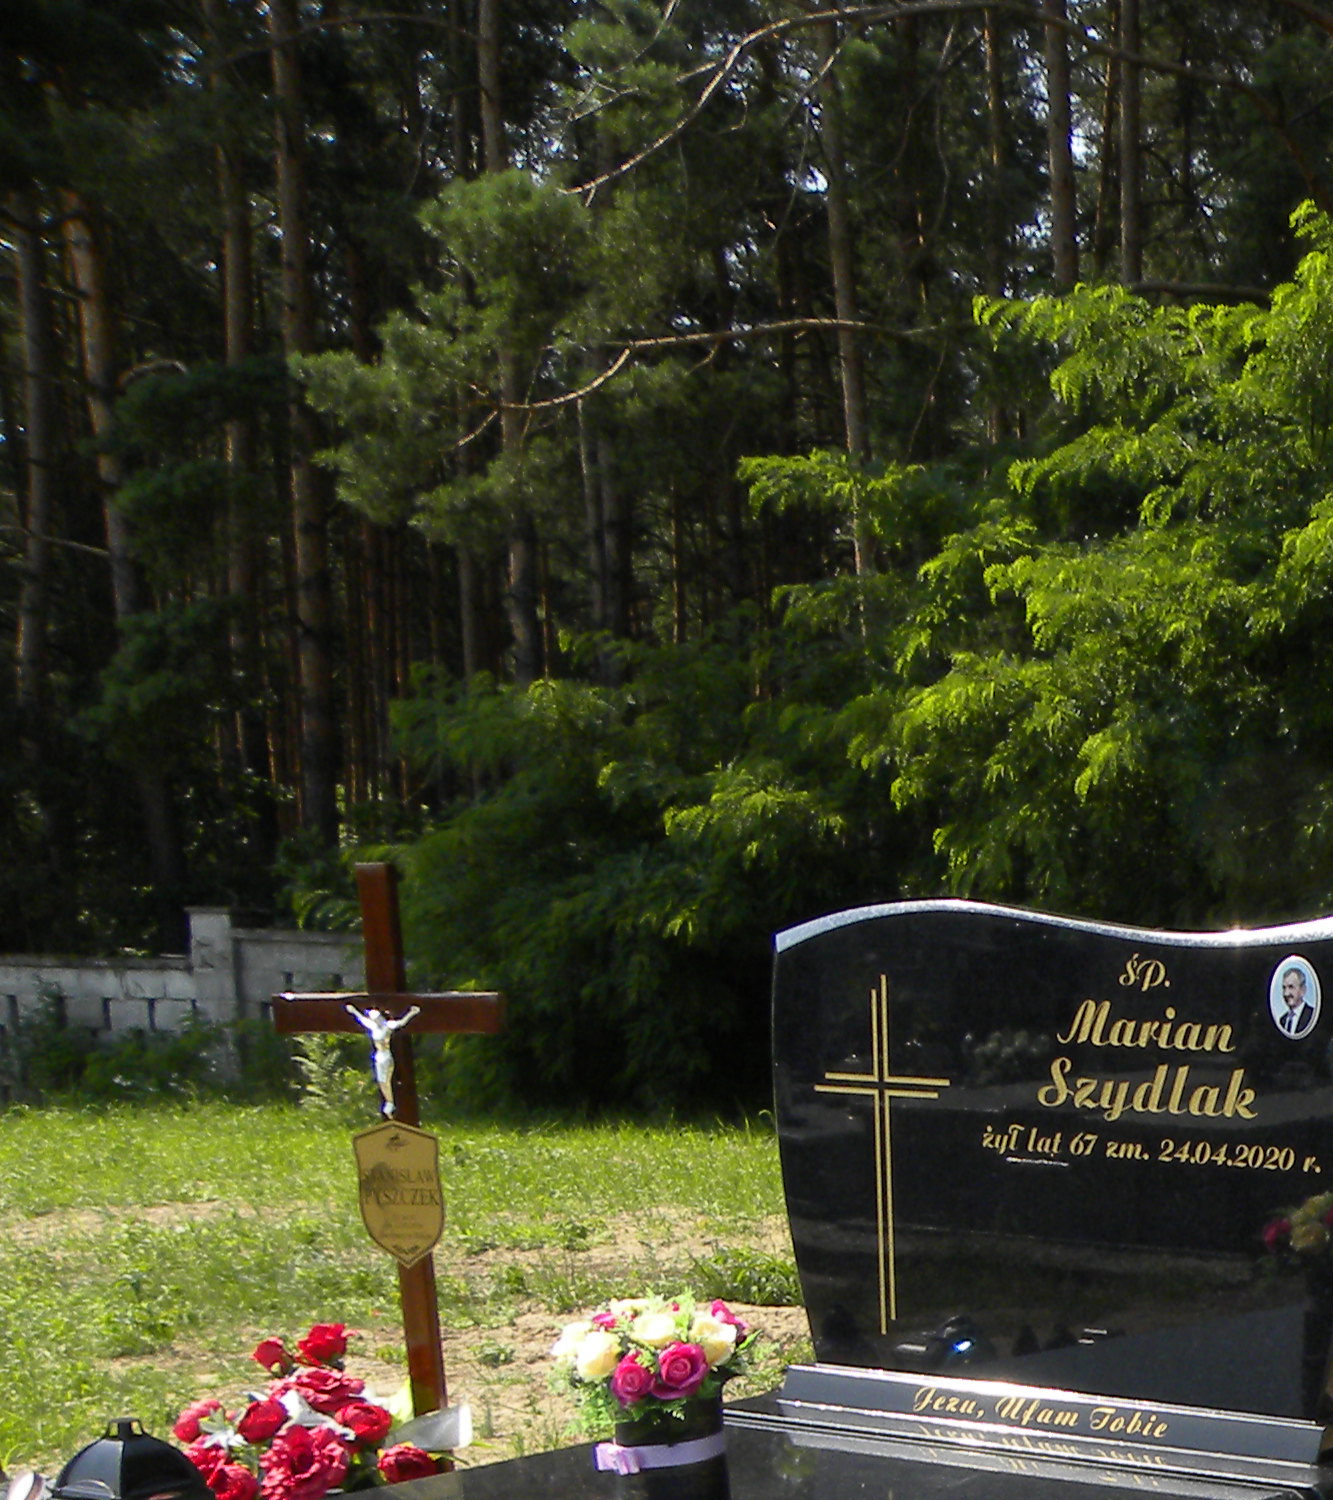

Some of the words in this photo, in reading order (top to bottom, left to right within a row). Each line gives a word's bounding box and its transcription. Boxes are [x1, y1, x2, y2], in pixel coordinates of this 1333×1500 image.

[1056, 999, 1237, 1053] Marian
[1036, 1056, 1259, 1122] Szydlak
[1028, 1127, 1062, 1156] lat
[1069, 1132, 1099, 1157] 67
[1105, 1140, 1150, 1161] zm.
[1157, 1138, 1296, 1172] 24.04.2020
[1302, 1155, 1322, 1174] r.
[914, 1386, 985, 1420] Jezu,
[995, 1396, 1079, 1428] Ufam
[1089, 1406, 1169, 1439] Tobie
